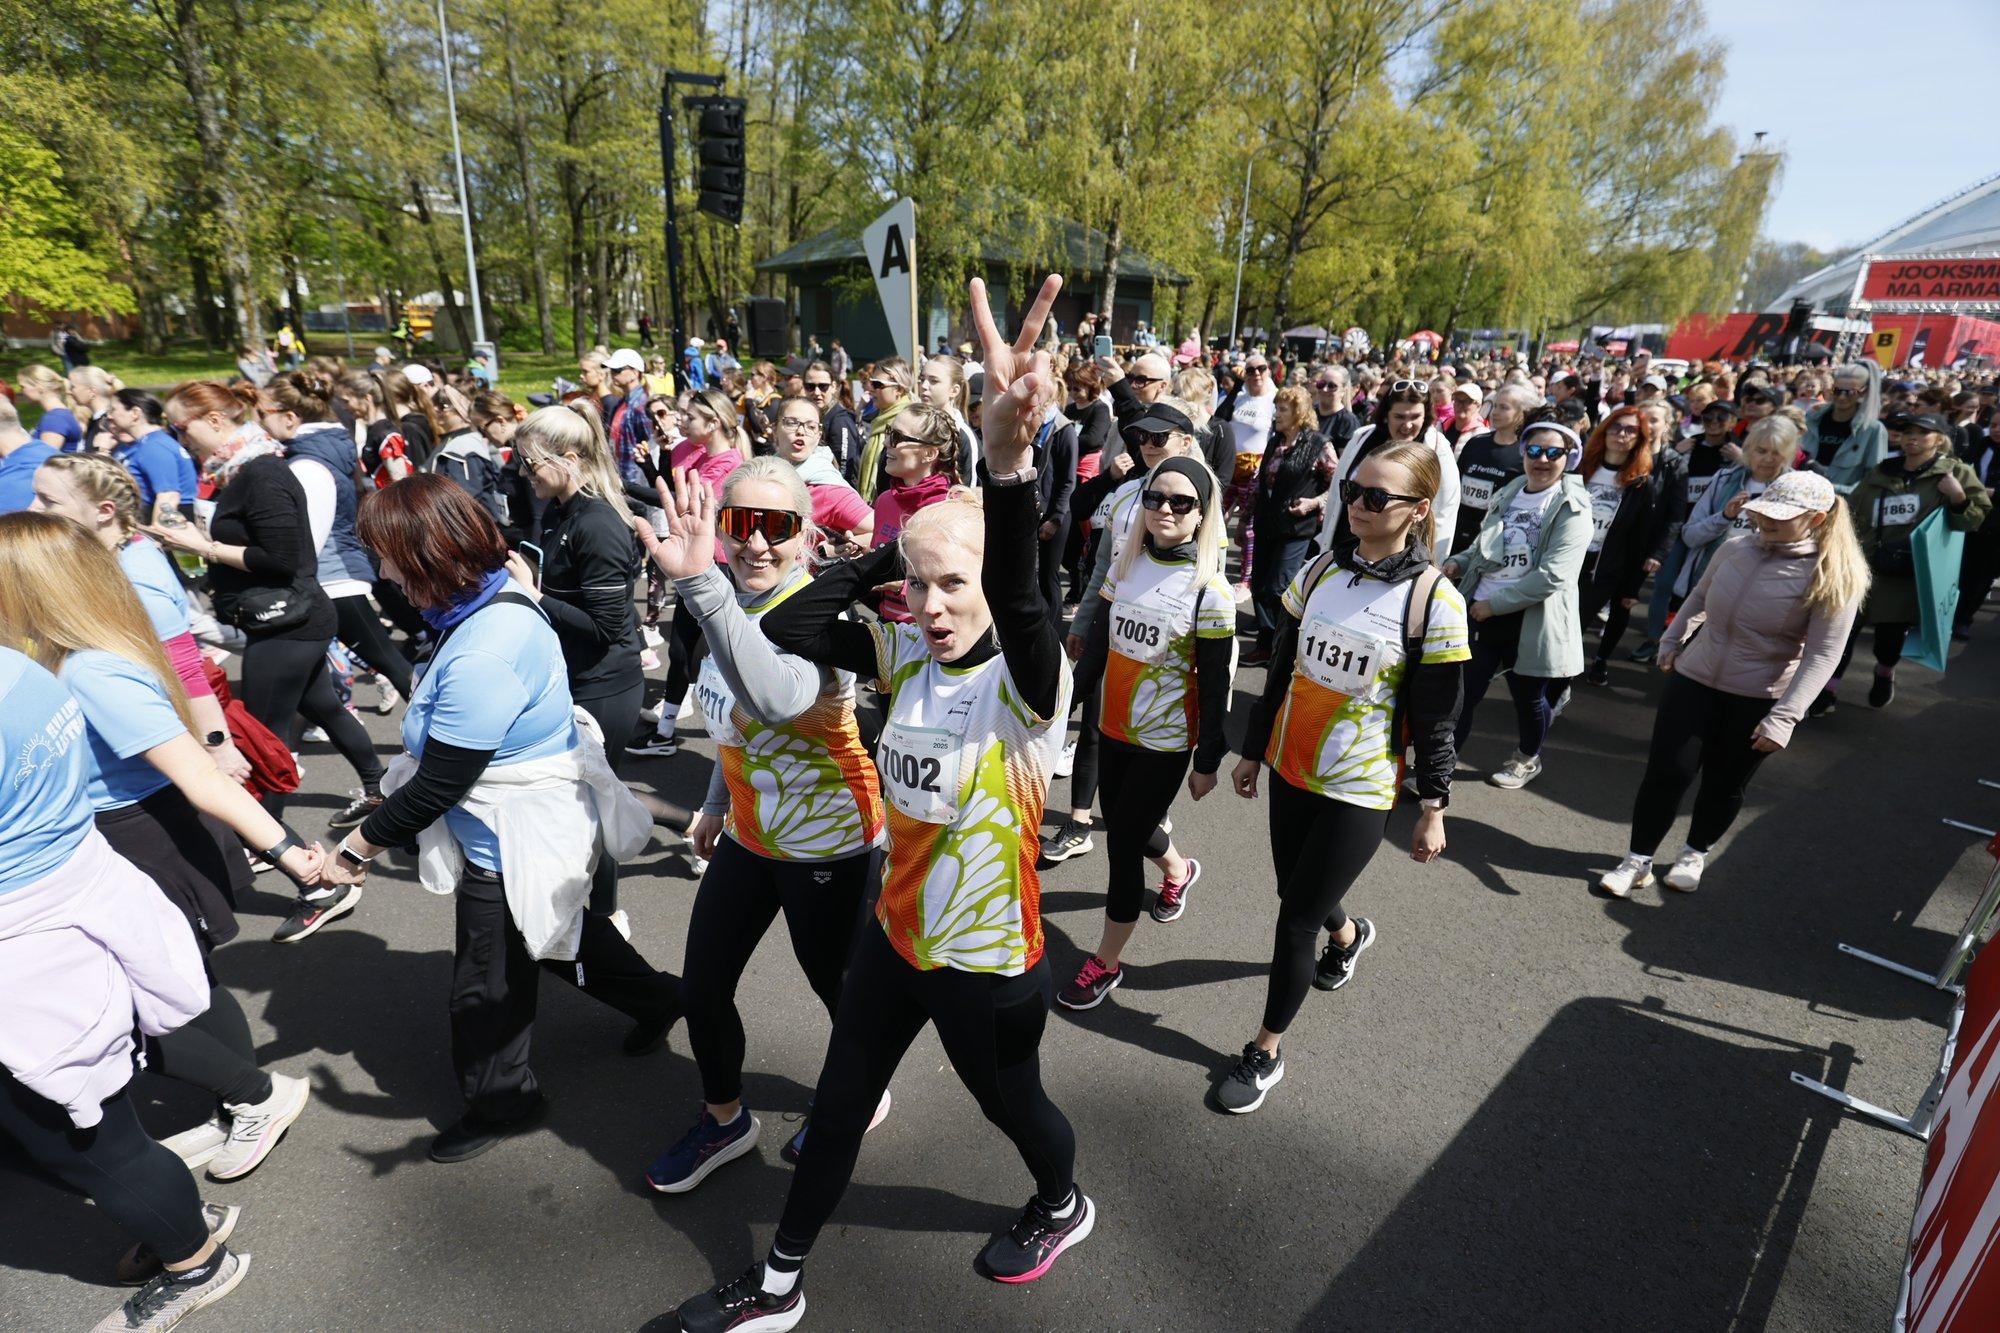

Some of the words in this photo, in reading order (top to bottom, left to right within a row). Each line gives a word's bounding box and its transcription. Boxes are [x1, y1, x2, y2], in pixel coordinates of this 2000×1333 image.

[880, 223, 910, 279] A
[1886, 282, 1921, 297] MA
[1877, 333, 1894, 348] B
[1463, 485, 1489, 500] 10788
[1883, 503, 1916, 516] 1863
[1502, 553, 1528, 568] 375
[1116, 615, 1160, 647] 7003
[1306, 635, 1370, 677] 11311
[933, 742, 949, 750] 2025
[881, 742, 941, 794] 7002
